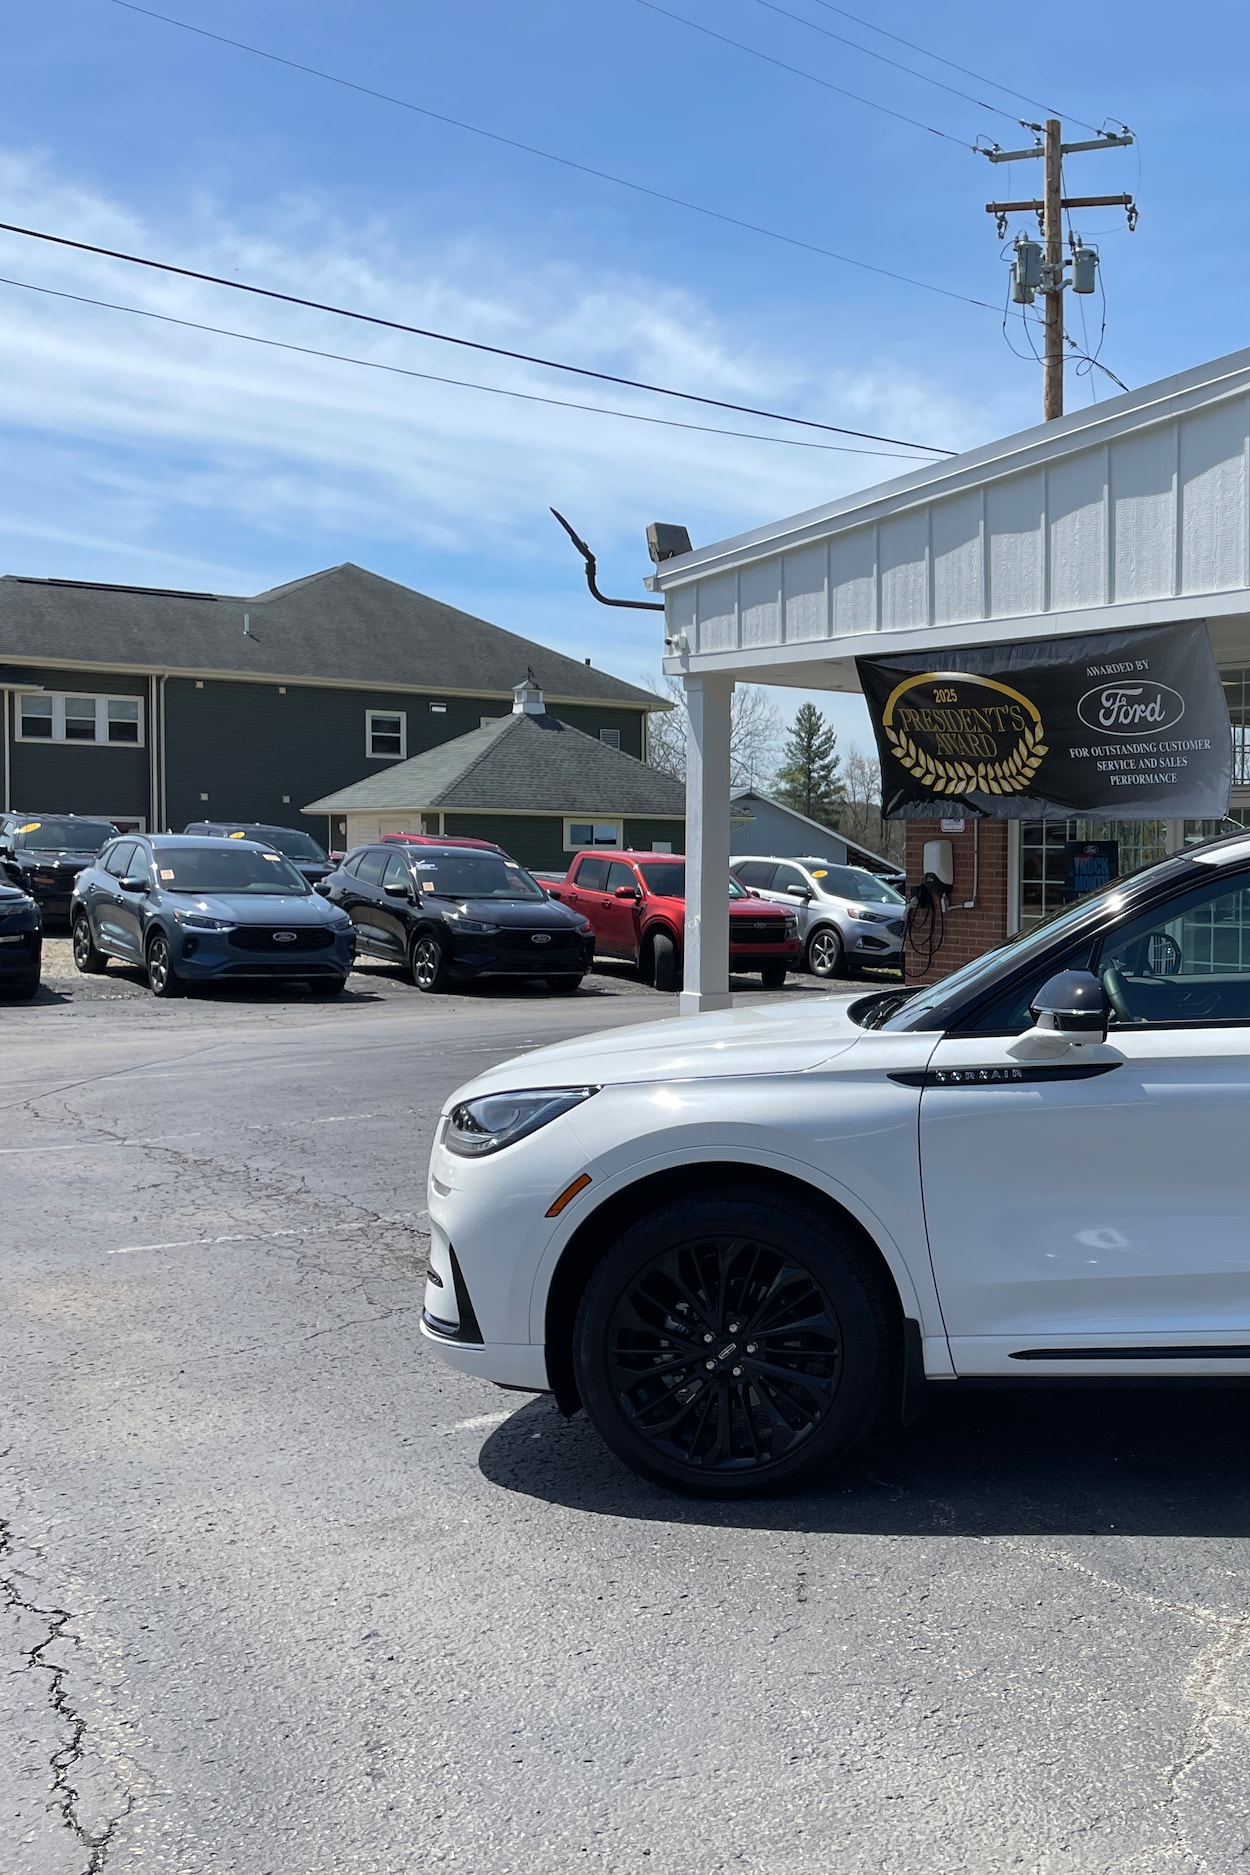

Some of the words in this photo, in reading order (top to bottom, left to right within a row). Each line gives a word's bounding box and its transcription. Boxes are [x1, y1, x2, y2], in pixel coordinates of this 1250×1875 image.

[1086, 662, 1133, 677] AWARDED
[1135, 659, 1150, 671] BY
[932, 688, 958, 704] 2025
[1098, 687, 1166, 727] Ford
[896, 704, 1026, 733] PRESIDENT'S
[935, 732, 997, 758] AWARD
[1069, 747, 1090, 759] FOR
[1091, 742, 1157, 758] OUTSTANDING
[1159, 739, 1212, 752] CUSTOMER
[1096, 759, 1136, 772] SERVICE
[1138, 758, 1158, 769] AND
[1159, 756, 1188, 768] SALES
[1110, 773, 1178, 786] PERFORMANCE
[935, 1069, 1023, 1081] CORSAIR
